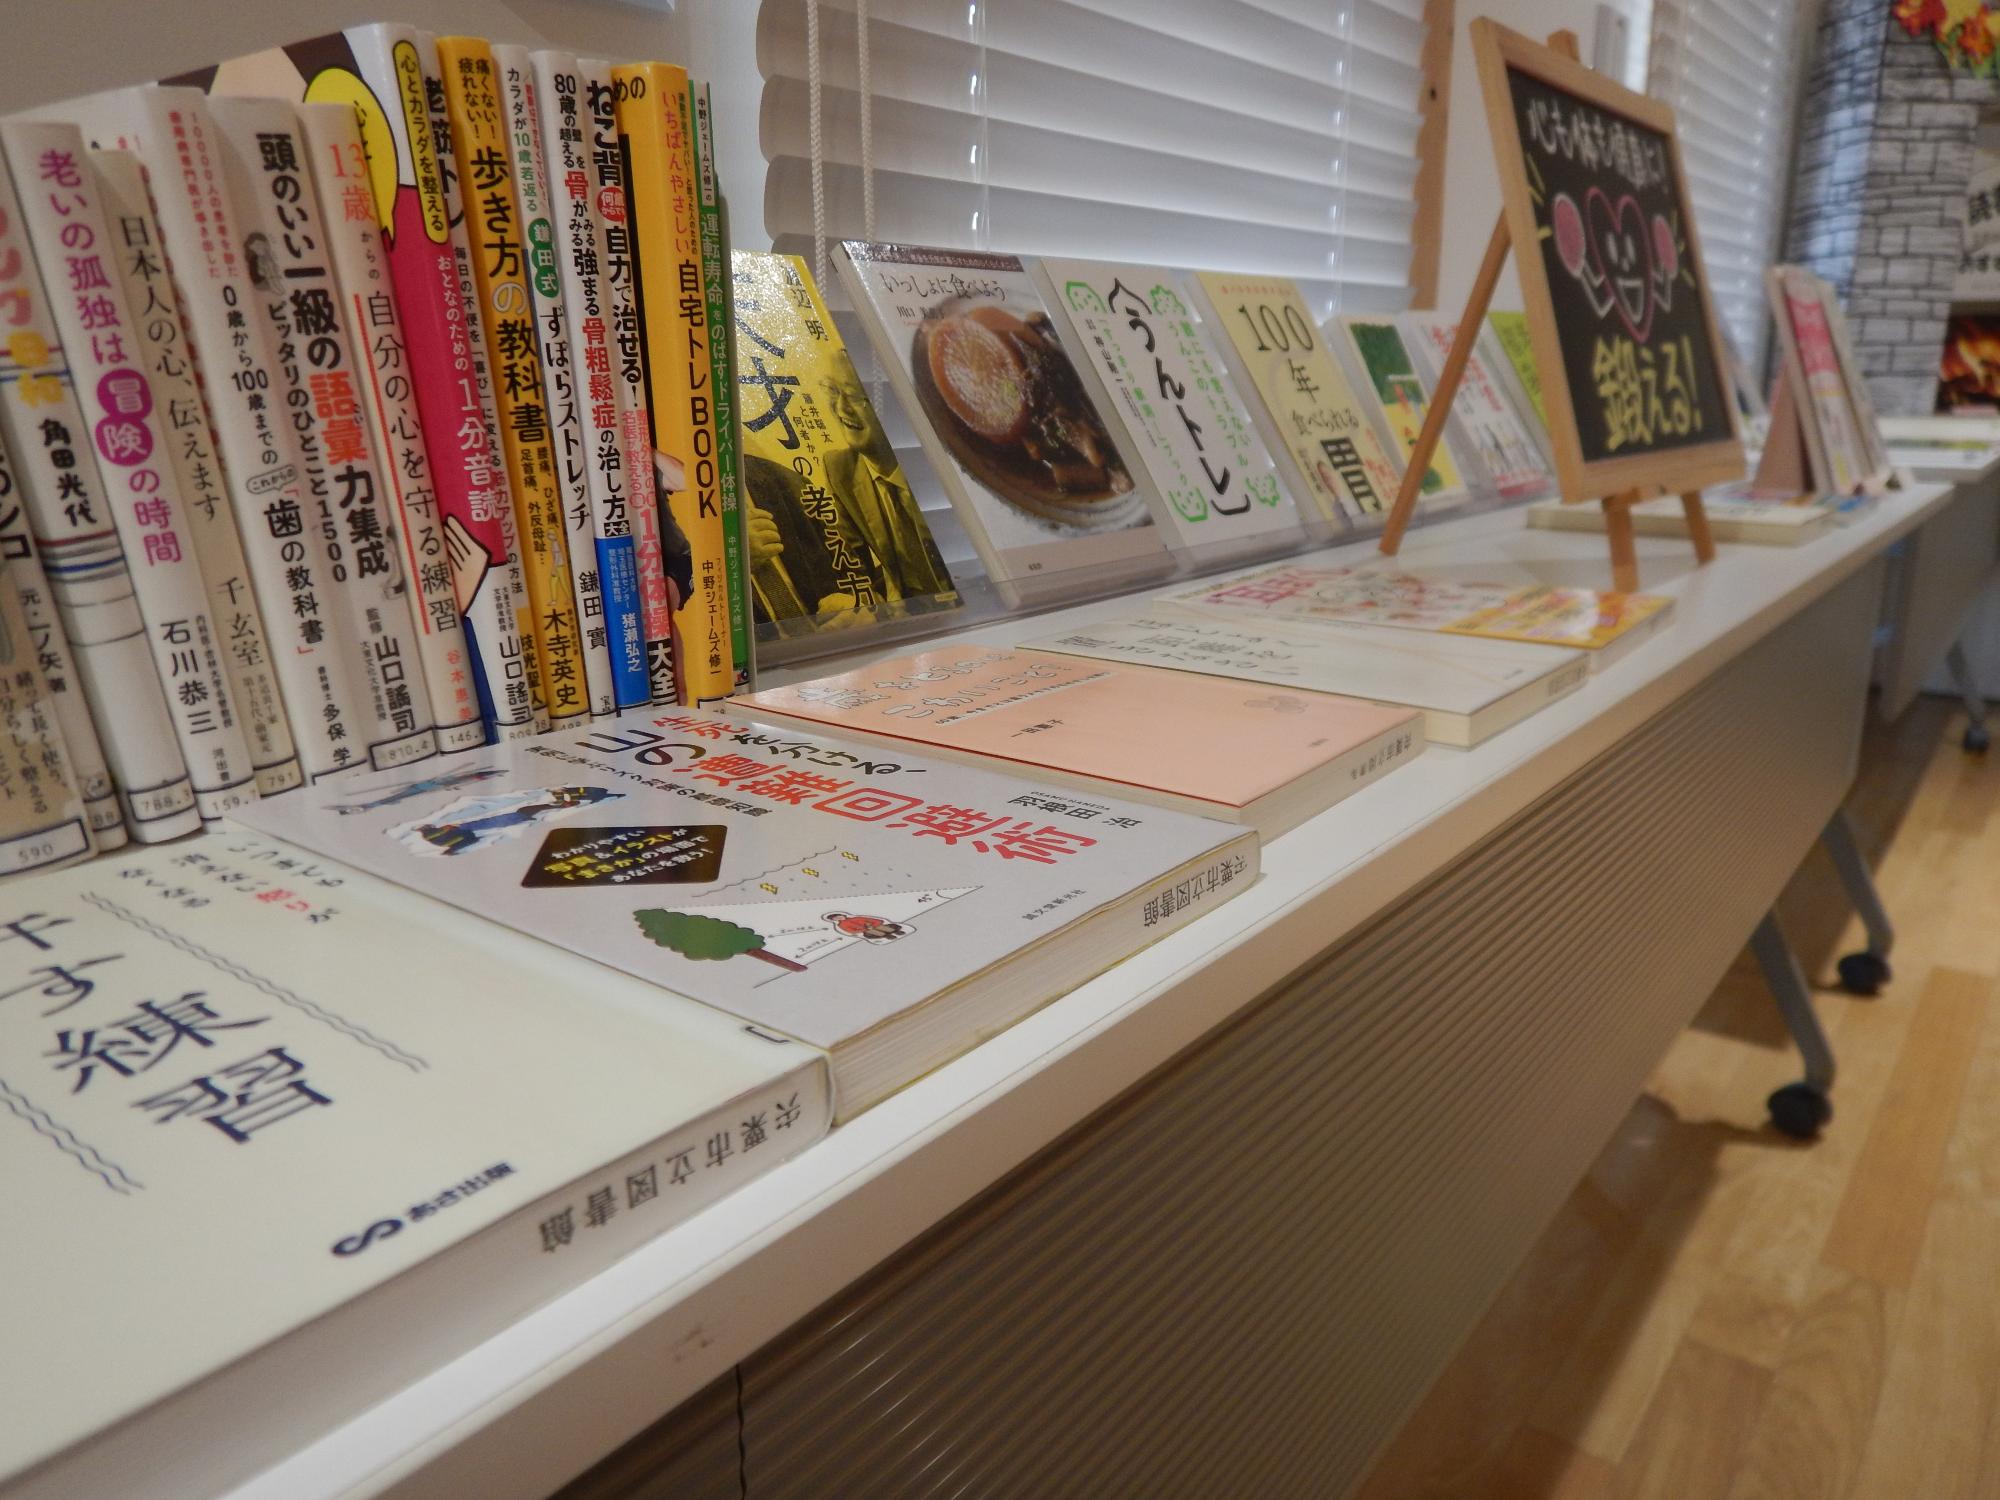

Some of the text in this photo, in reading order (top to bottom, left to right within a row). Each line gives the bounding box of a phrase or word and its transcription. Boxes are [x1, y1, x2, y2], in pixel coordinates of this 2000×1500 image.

[401, 54, 445, 233] 心とカラダを整える
[507, 67, 538, 212] カラダが10歳若返る
[586, 79, 624, 187] ねこ背
[662, 92, 691, 253] いちばんやさしい
[38, 148, 183, 567] 老いの孤独は冒険の時間
[437, 255, 469, 372] おとなのための
[470, 146, 548, 444] 歩き方の教科書
[605, 225, 643, 408] 自力で治せる！
[879, 273, 1006, 301] いっしょに食べよう
[120, 215, 221, 522] 日本人の心、伝えます
[222, 284, 280, 467] 0歳から100歳までの
[581, 316, 627, 521] 骨粗鬆症の治し方
[679, 259, 718, 520] 自宅トレBOOK
[700, 213, 737, 513] 運転寿命をのばすドライバー体操
[38, 418, 98, 527] 角田光代
[367, 290, 459, 633] 自分の心を守る練習
[456, 378, 503, 523] 1分音読
[216, 576, 264, 667] 千玄室
[263, 487, 326, 656] 「歯の教科書」
[621, 612, 642, 673] 猪瀬弘之
[701, 559, 723, 675] 中野ジェームズ修一
[159, 619, 218, 735] 石川恭三
[543, 608, 580, 709] 木寺英史
[649, 640, 675, 697] 大全
[574, 728, 1099, 866] 山の遭難回避術
[1143, 855, 1248, 929] 宍粟市立図書館
[539, 1091, 802, 1254] 宍粟市立図書館
